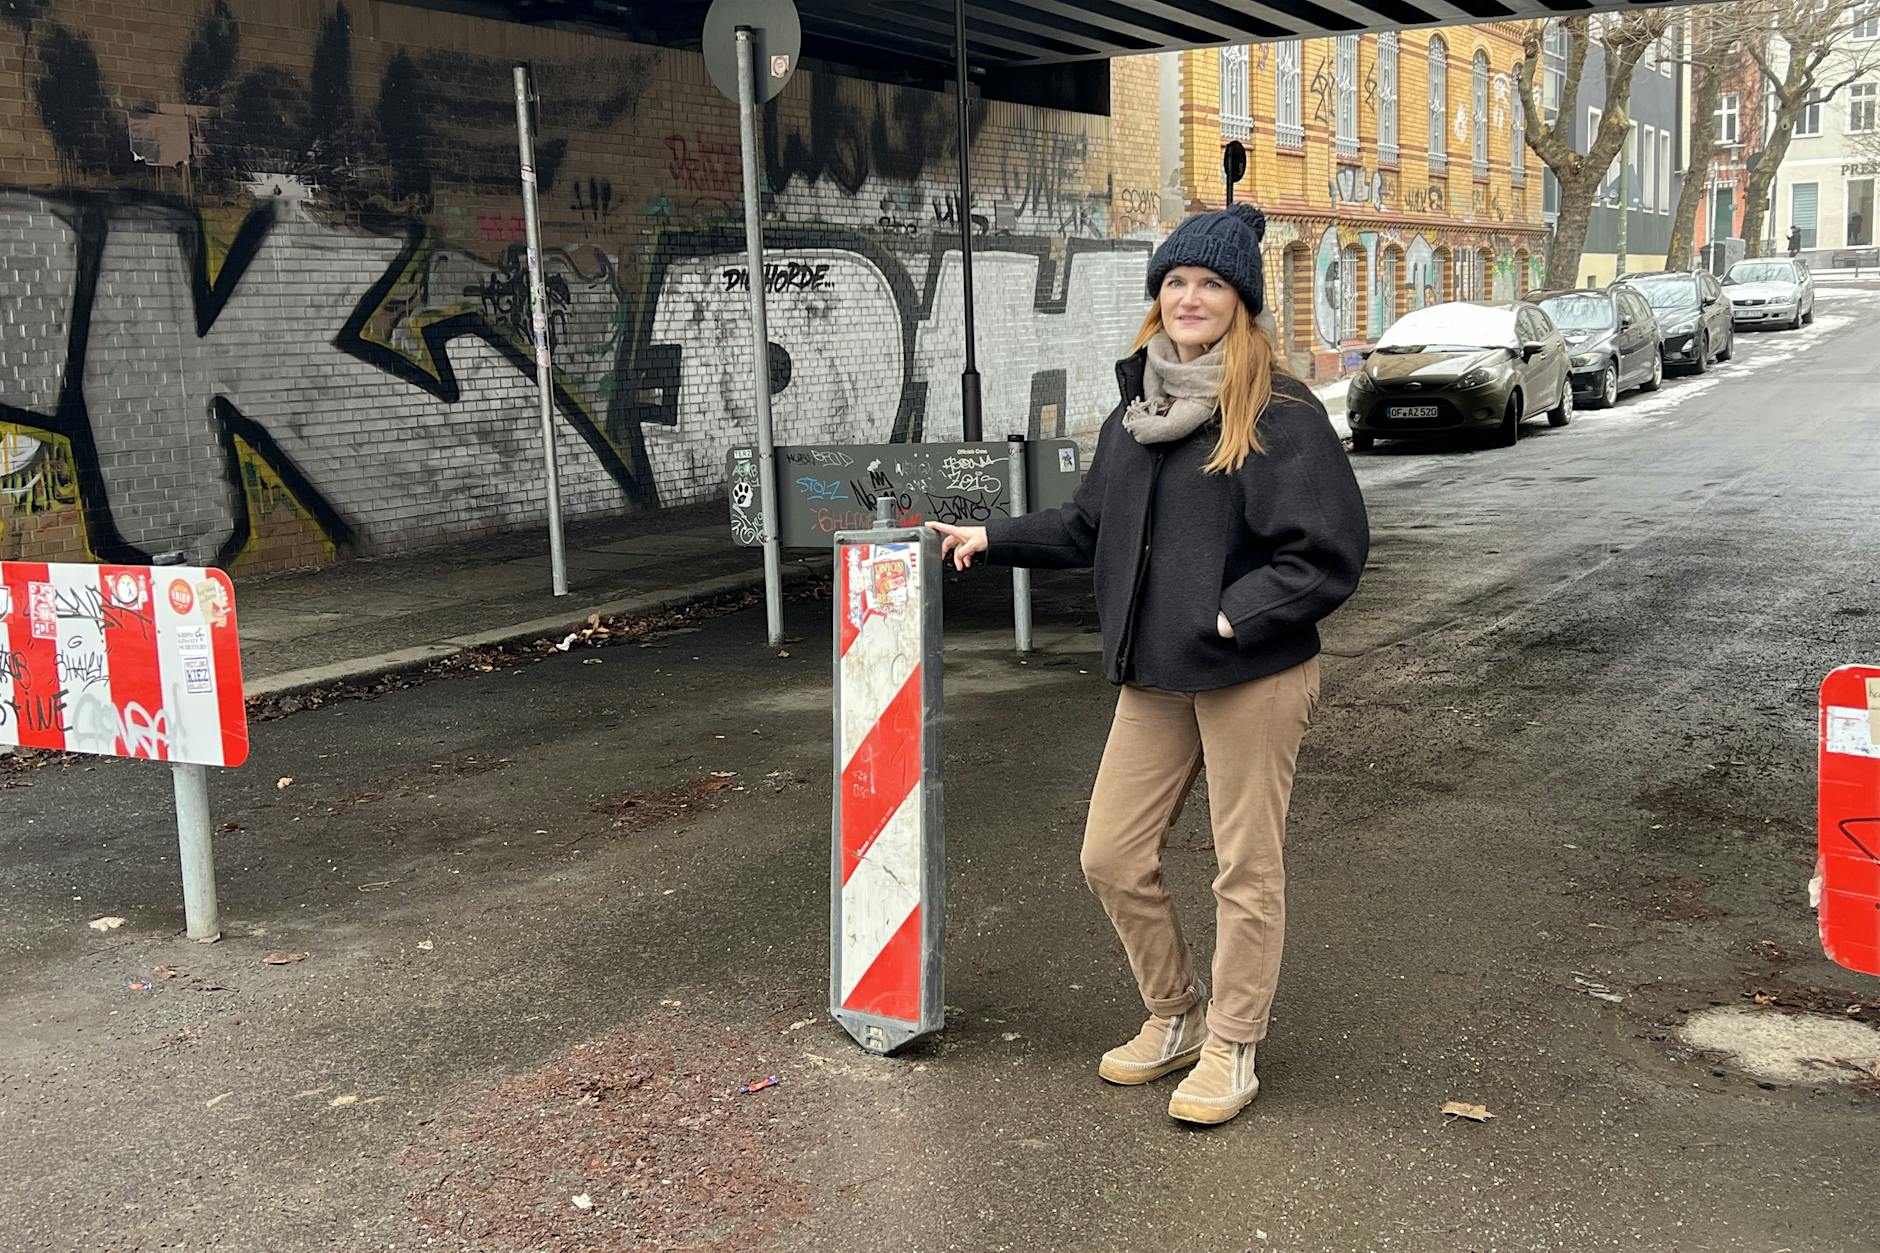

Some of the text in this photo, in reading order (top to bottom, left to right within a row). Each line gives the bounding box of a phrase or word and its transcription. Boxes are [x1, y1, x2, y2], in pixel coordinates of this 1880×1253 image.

[1840, 162, 1880, 176] PRES
[1391, 407, 1437, 417] OF AZ 520
